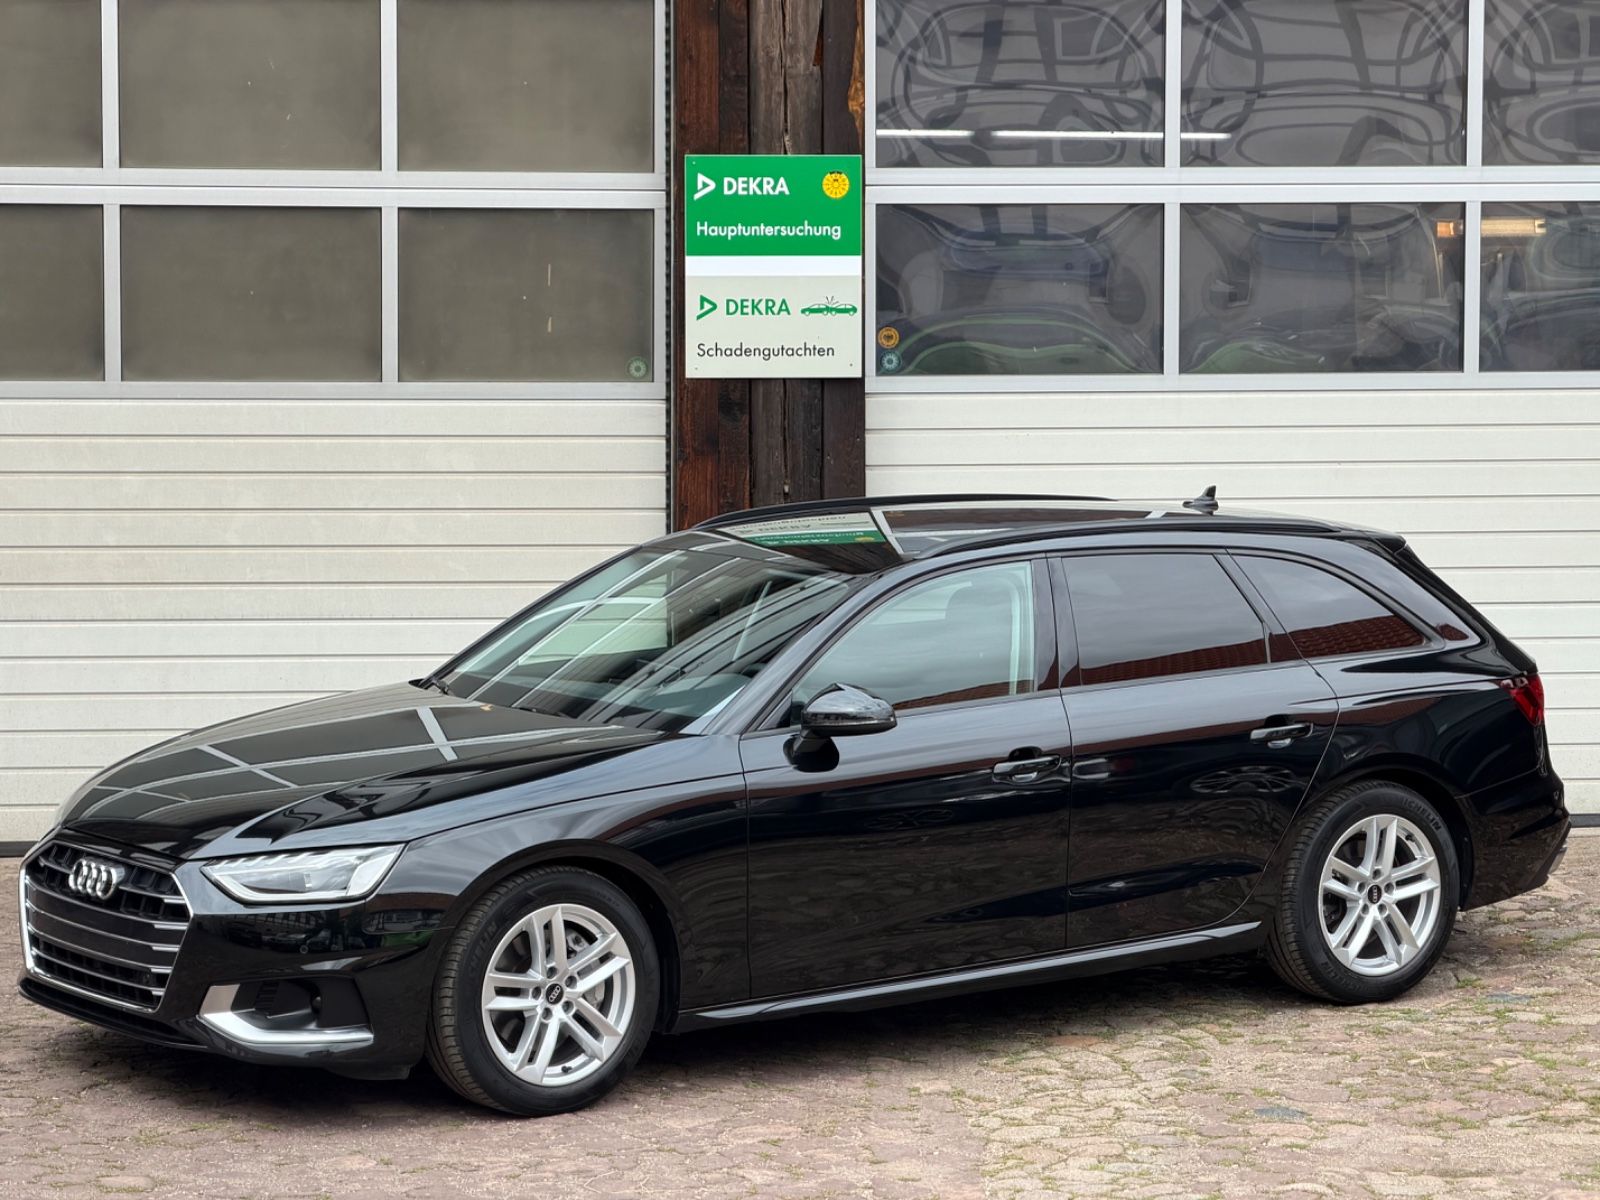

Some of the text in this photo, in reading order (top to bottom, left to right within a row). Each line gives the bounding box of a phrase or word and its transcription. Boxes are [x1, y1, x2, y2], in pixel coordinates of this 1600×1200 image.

[723, 177, 790, 195] DEKRA
[696, 220, 841, 240] Hauptuntersuchung
[725, 298, 791, 315] DEKRA
[697, 342, 835, 361] Schadengutachten
